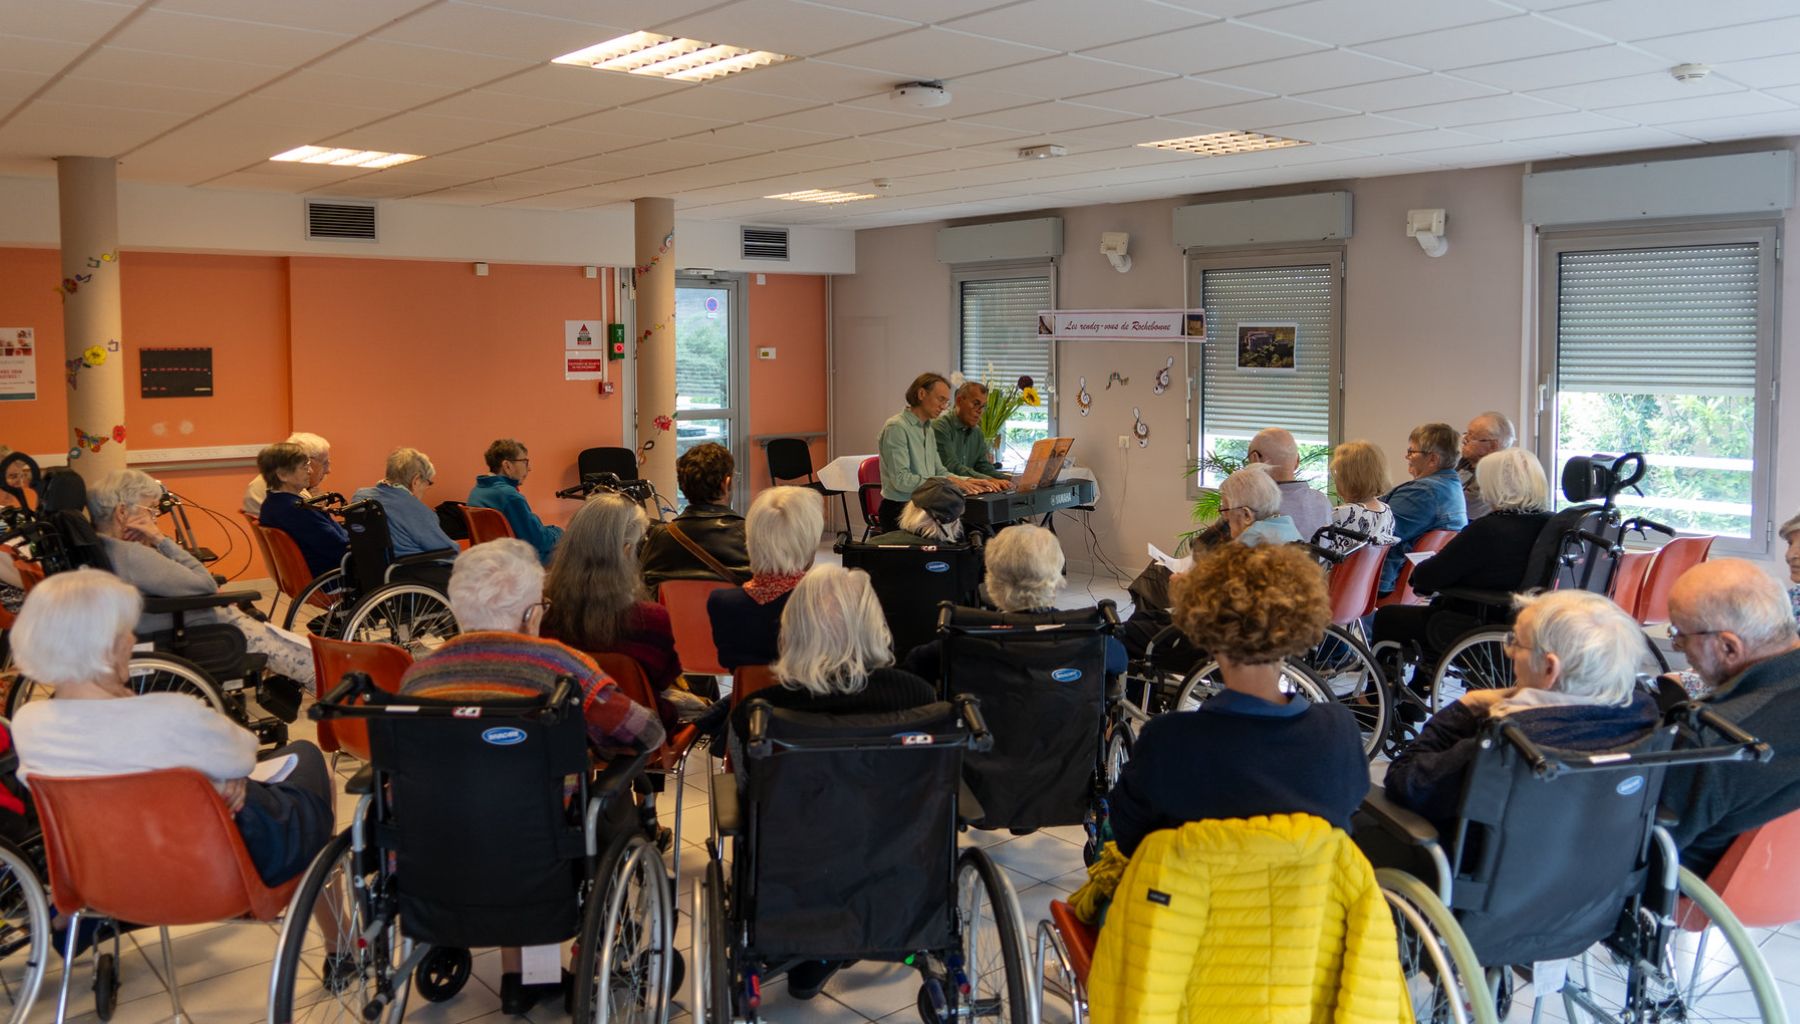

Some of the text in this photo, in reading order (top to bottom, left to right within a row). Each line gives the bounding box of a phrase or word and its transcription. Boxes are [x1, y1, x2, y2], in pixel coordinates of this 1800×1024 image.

[1065, 321, 1171, 332] Les rendez-vous de Rochebonne
[1056, 492, 1072, 505] YAMAHA
